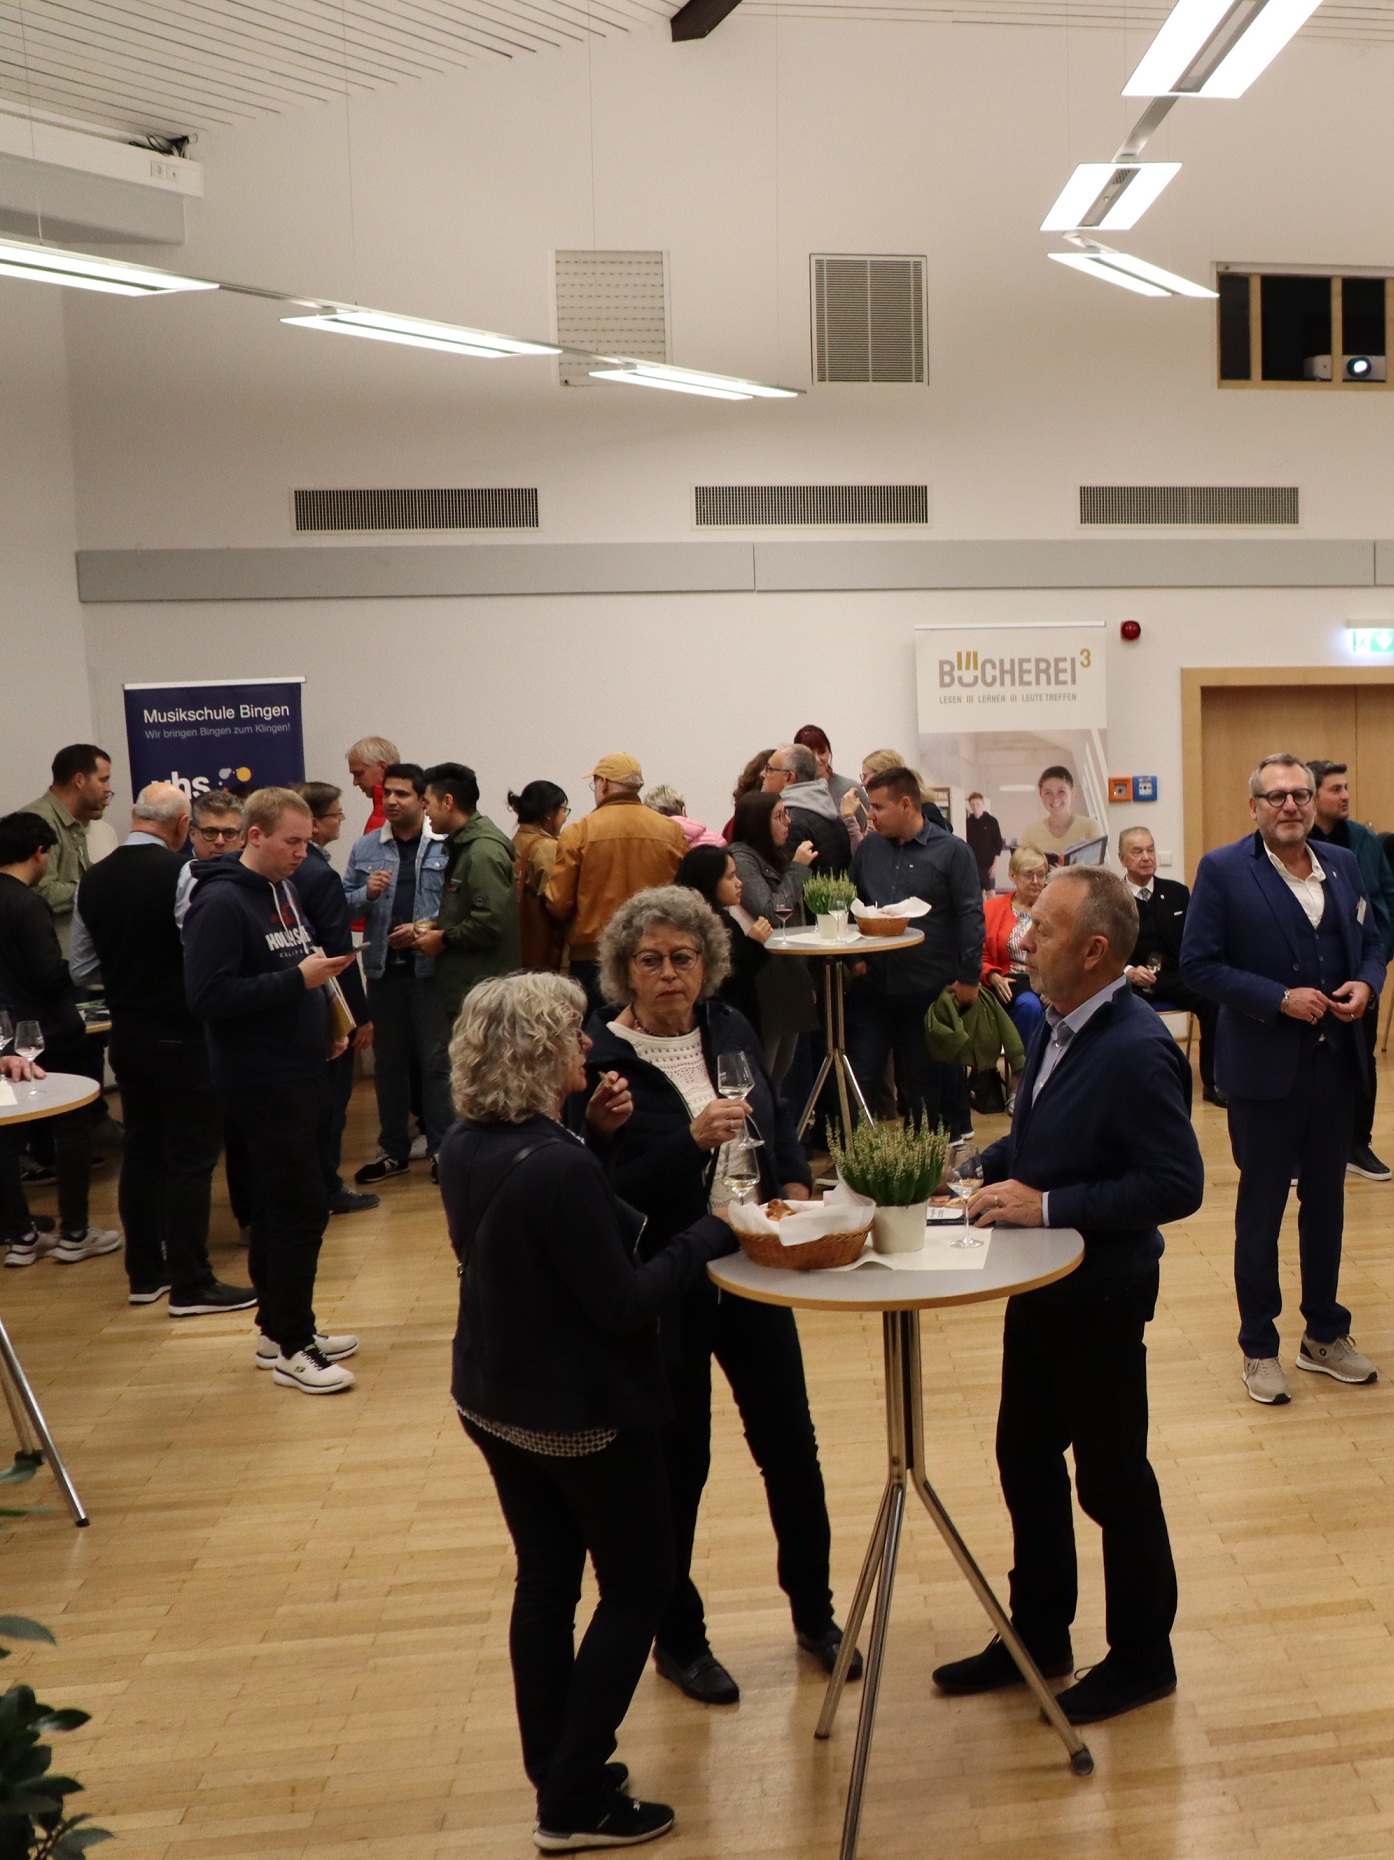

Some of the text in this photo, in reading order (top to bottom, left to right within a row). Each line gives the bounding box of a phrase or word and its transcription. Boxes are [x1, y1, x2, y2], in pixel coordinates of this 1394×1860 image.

[939, 692, 1077, 704] LESEN LERNEN LEUTE TREFFEN
[143, 704, 290, 724] Musikschule Bingen
[144, 722, 291, 741] Wir bringen Bingen zum Klingen!
[151, 771, 211, 800] hs
